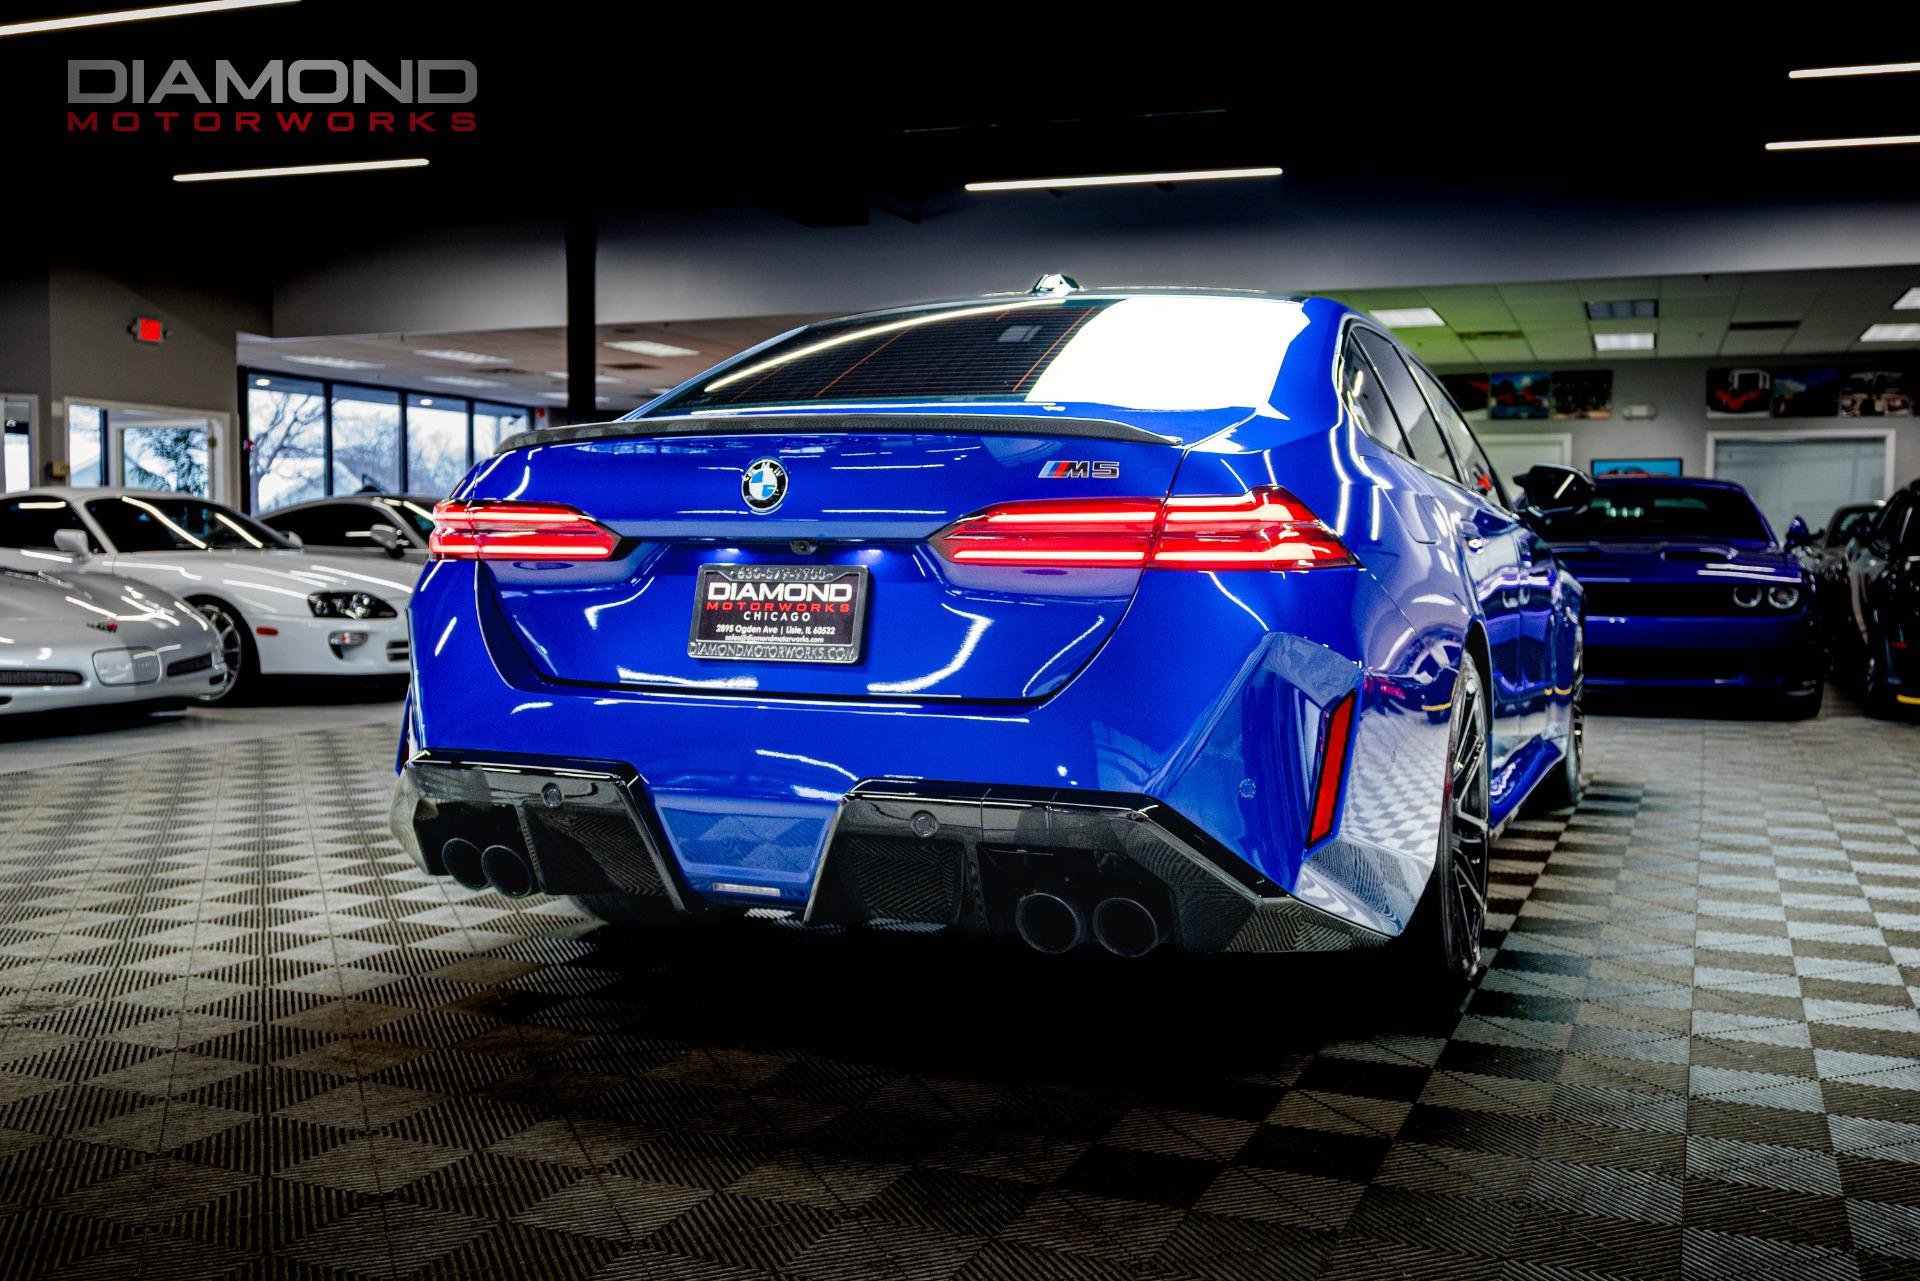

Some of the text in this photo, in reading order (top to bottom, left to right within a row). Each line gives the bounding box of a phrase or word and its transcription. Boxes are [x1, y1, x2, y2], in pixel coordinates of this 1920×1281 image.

[1058, 461, 1120, 478] M5
[707, 582, 853, 602] DIAMOND
[706, 602, 850, 613] MOTORWORKS
[743, 611, 811, 622] CHICAGO
[735, 624, 761, 634] Ogden
[762, 625, 778, 634] Ave
[786, 626, 804, 635] Lisle,
[689, 641, 855, 661] DIAMONDMOTORWORKS.COM
